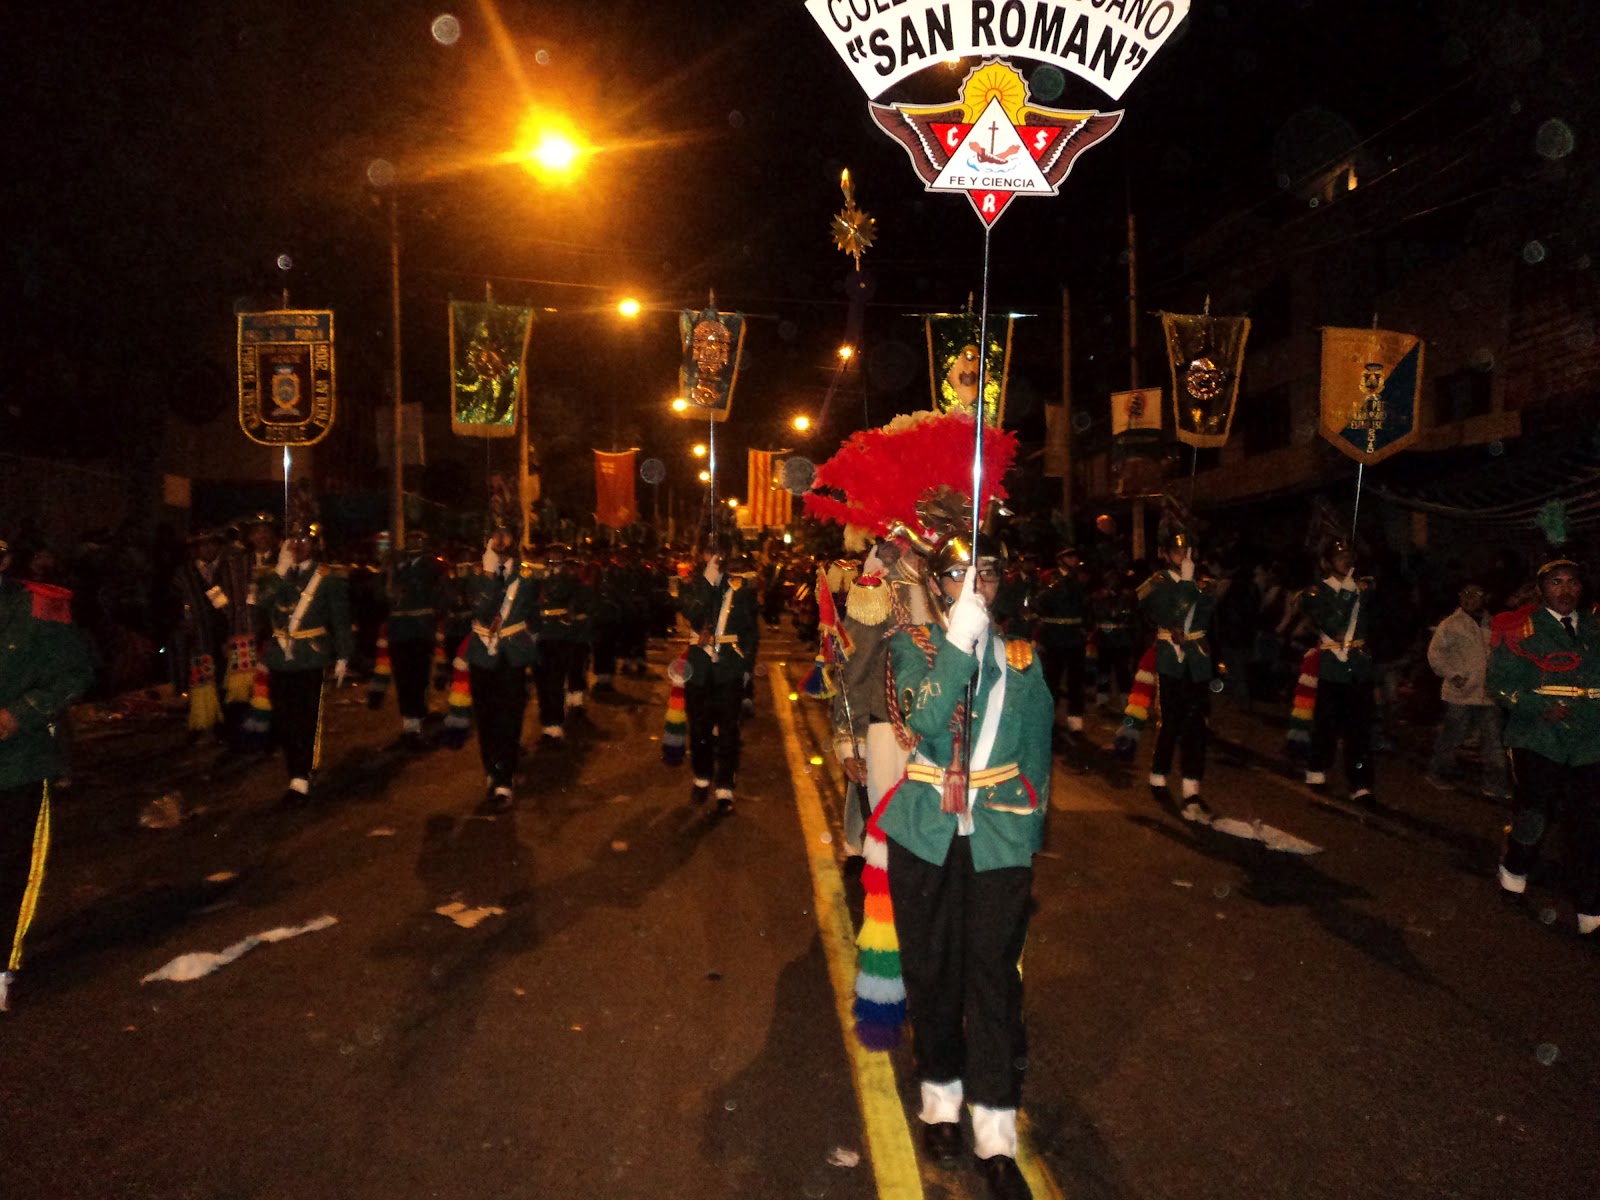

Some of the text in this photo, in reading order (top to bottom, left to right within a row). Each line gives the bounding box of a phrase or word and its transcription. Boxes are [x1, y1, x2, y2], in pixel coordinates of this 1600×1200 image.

[947, 126, 958, 147] C
[1033, 129, 1049, 150] S
[949, 176, 1035, 188] FE Y CIENCIA
[982, 193, 995, 213] R
